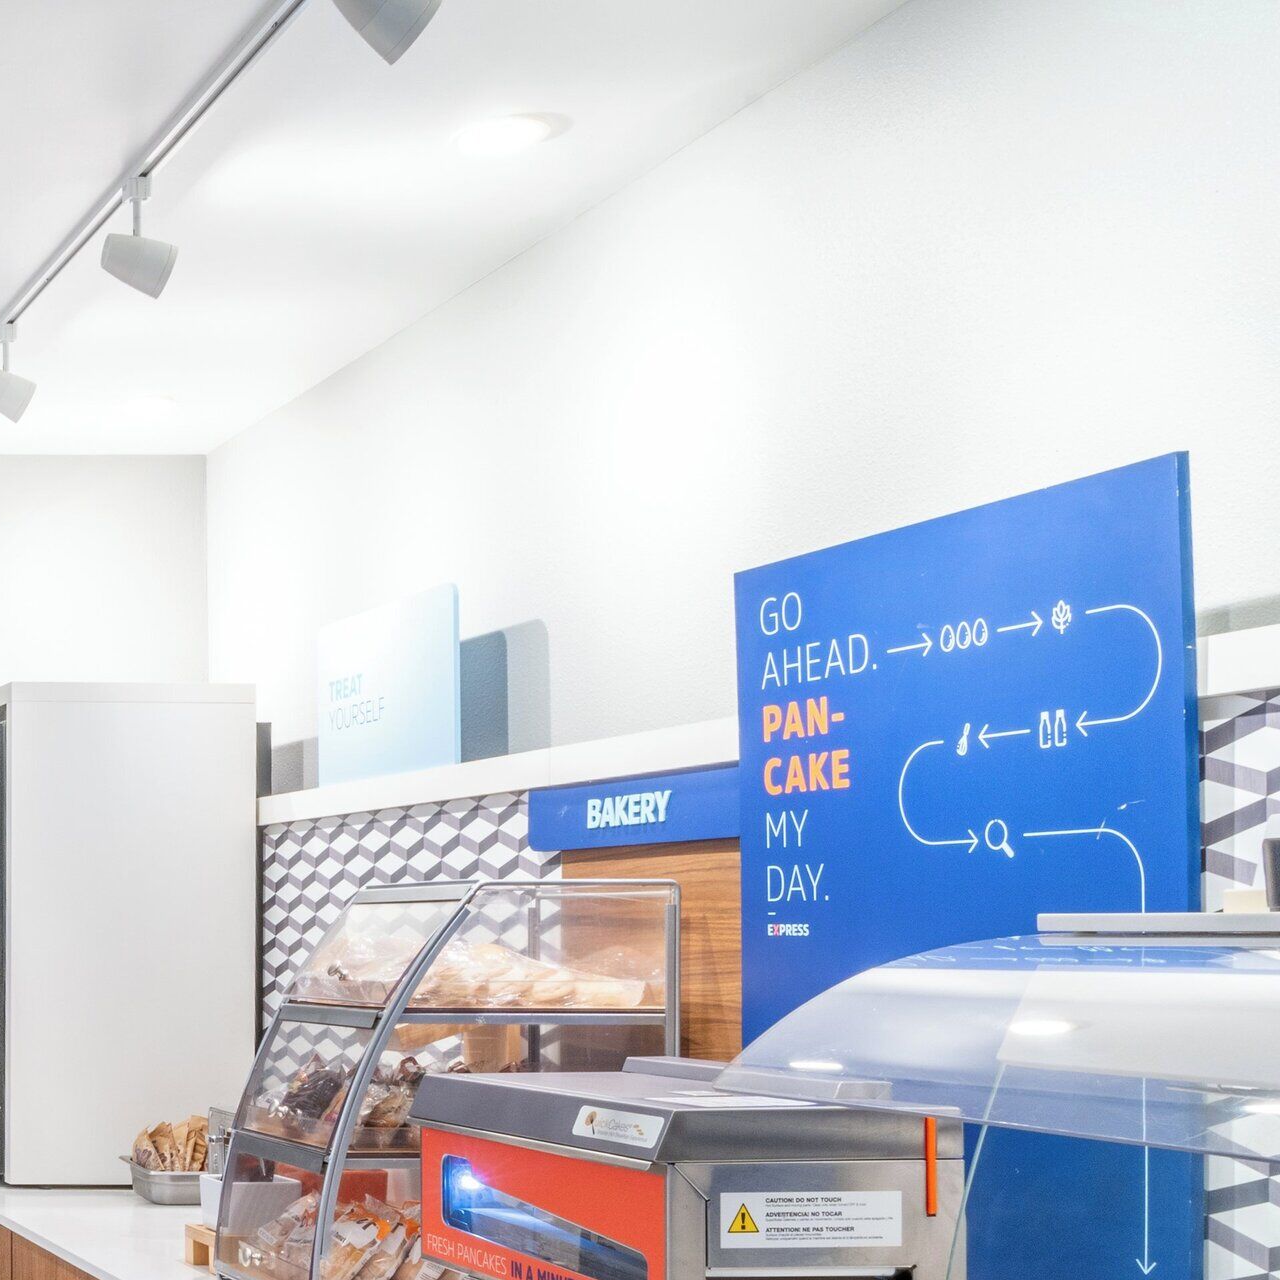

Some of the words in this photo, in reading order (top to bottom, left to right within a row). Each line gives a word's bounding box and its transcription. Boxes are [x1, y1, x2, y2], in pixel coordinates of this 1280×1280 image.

[760, 591, 802, 636] GO
[761, 633, 878, 690] AHEAD.
[328, 672, 363, 703] TREAT
[328, 696, 385, 731] YOURSELF
[762, 695, 846, 744] PAN-
[763, 749, 851, 797] CAKE
[586, 789, 672, 830] BAKERY
[765, 808, 809, 850] MY
[766, 862, 830, 903] DAY.
[767, 923, 810, 938] EXPRESS
[426, 1233, 455, 1258] FRESH
[457, 1242, 507, 1276] PANCAKES
[511, 1260, 523, 1280] IN
